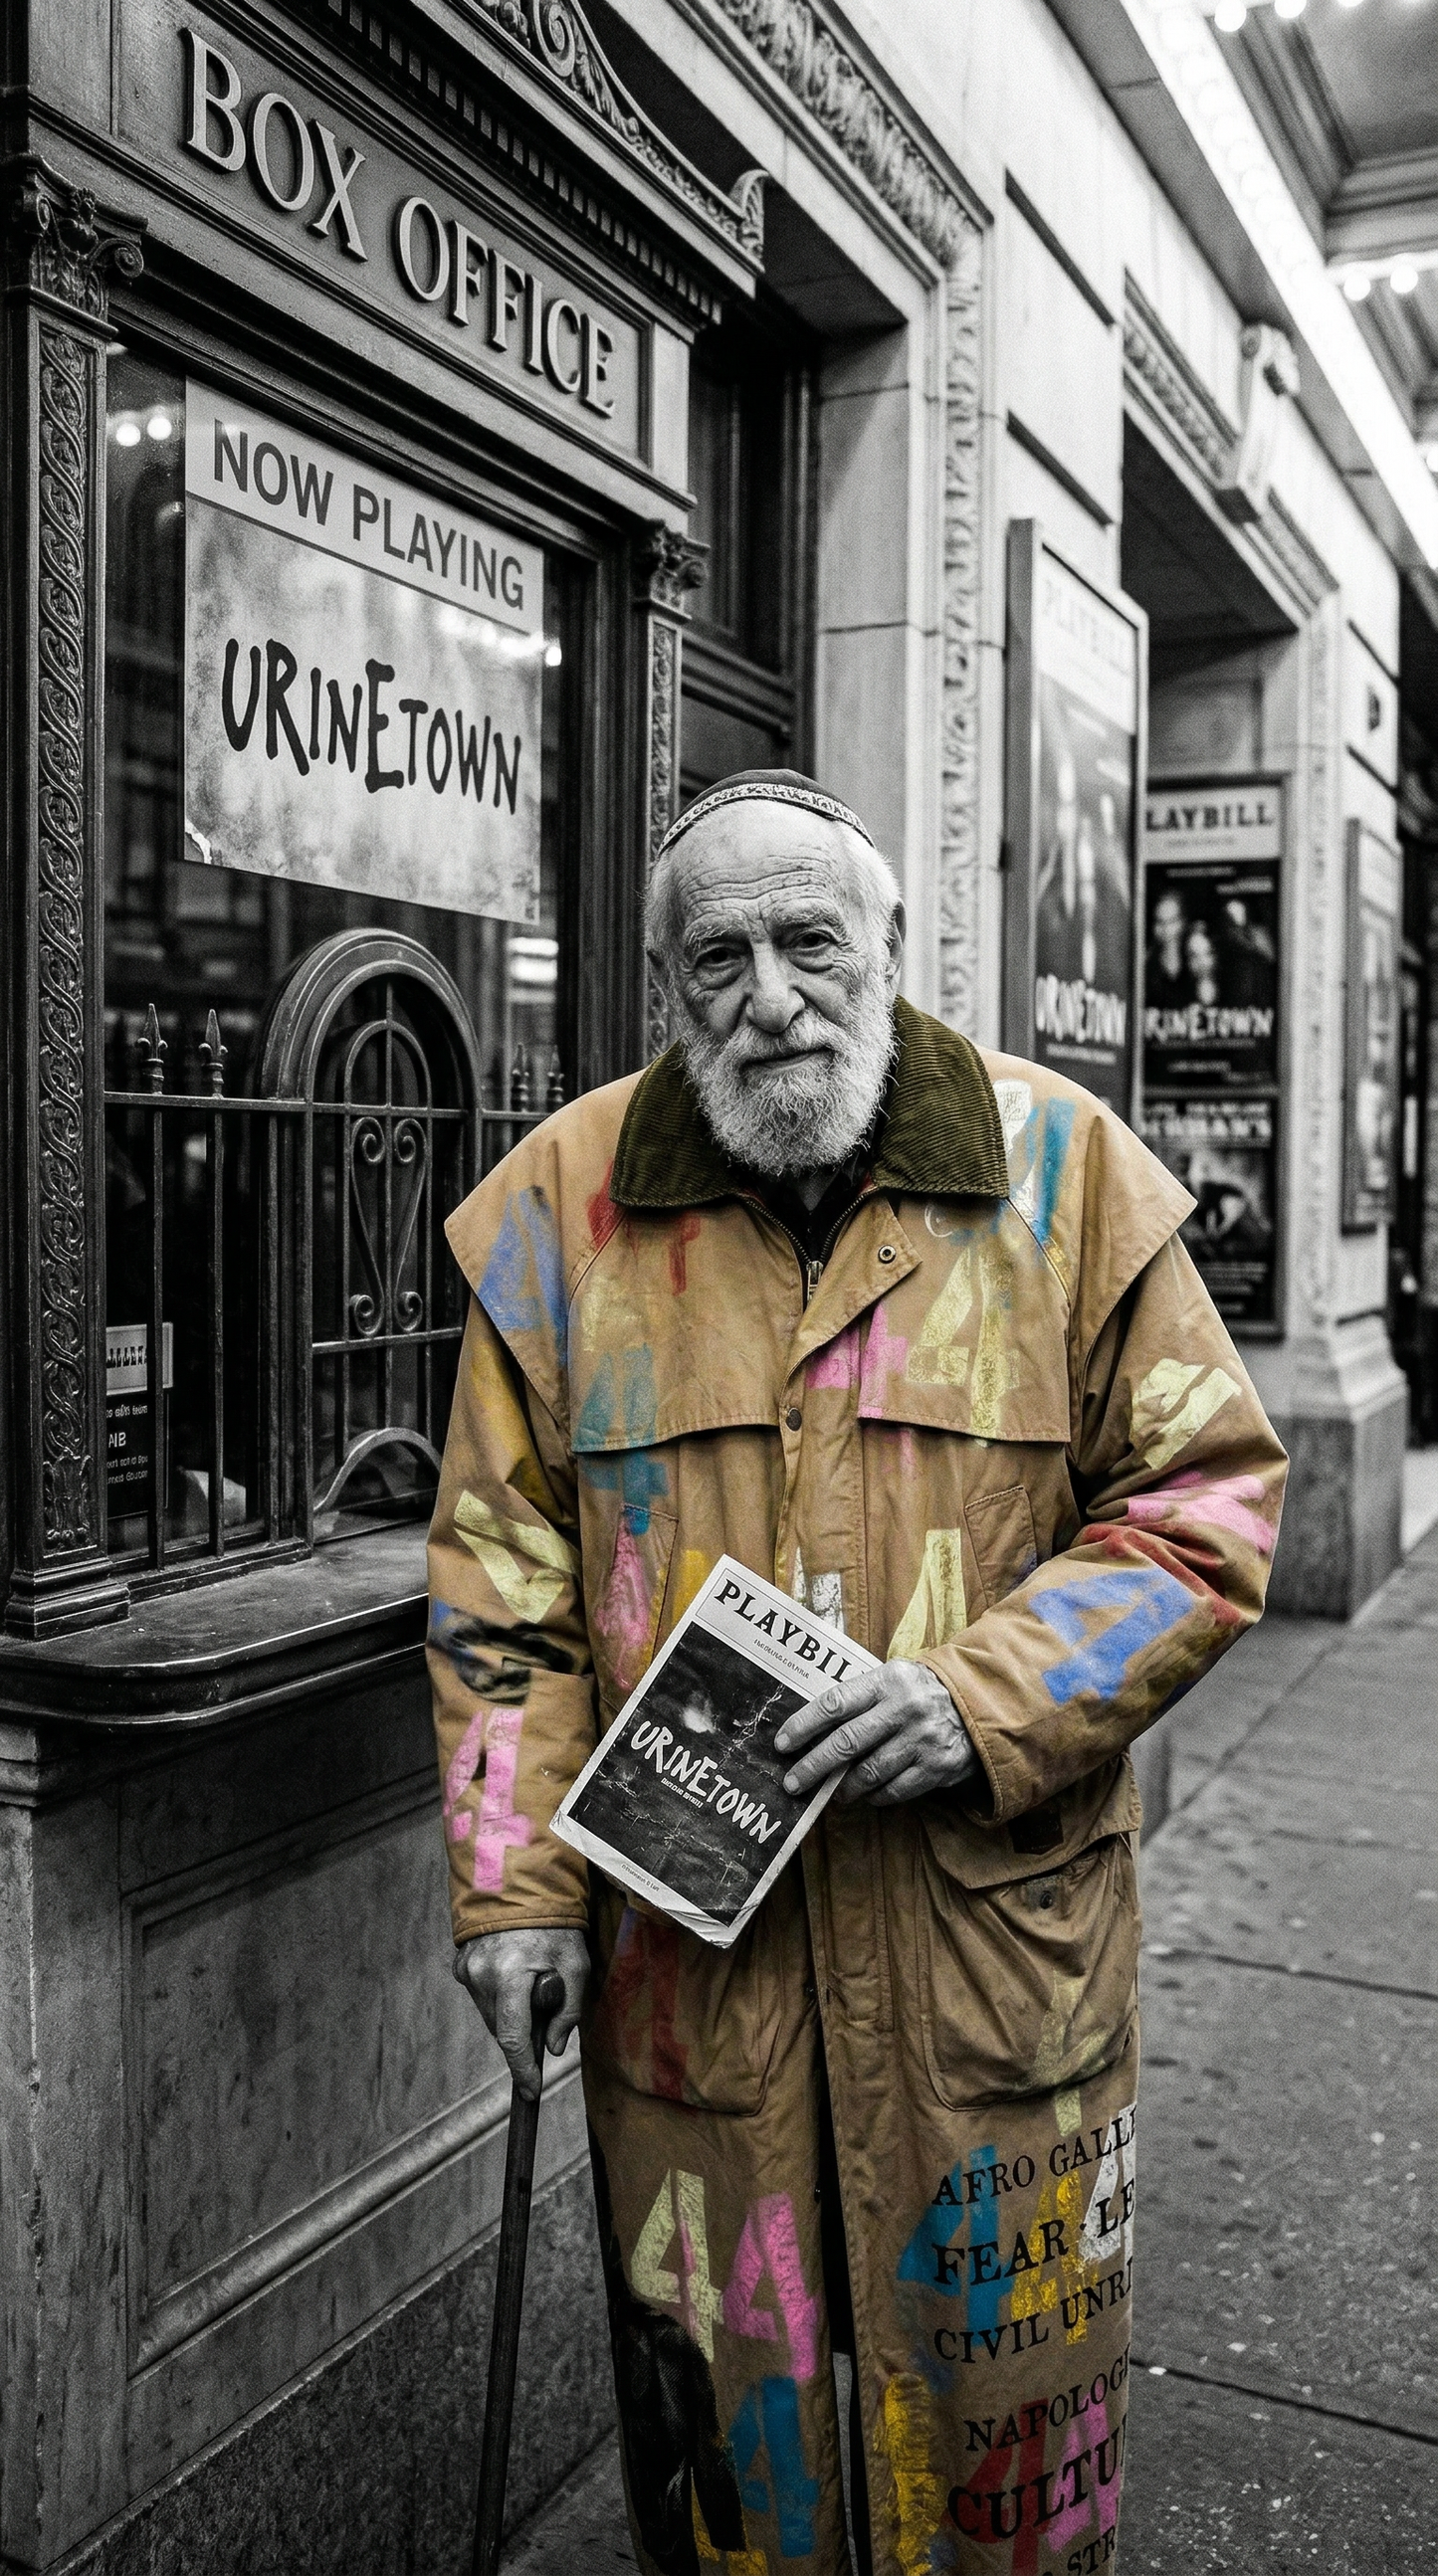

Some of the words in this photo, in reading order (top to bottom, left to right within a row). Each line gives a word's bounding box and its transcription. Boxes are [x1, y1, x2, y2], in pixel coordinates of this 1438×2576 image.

[181, 28, 368, 262] BOX
[397, 195, 616, 418] OFFICE
[212, 419, 334, 526] NOW
[352, 484, 524, 611] PLAYING
[221, 637, 521, 816] URINETOWN
[1145, 801, 1275, 832] LAYBILL
[1144, 1004, 1275, 1043] RINETOWN
[714, 1578, 866, 1684] PLAYBIL
[630, 1720, 782, 1845] URINETOWN
[931, 2153, 1036, 2207] AFRO
[931, 2219, 1070, 2288] FEAR
[933, 2311, 1050, 2365] CIVIL
